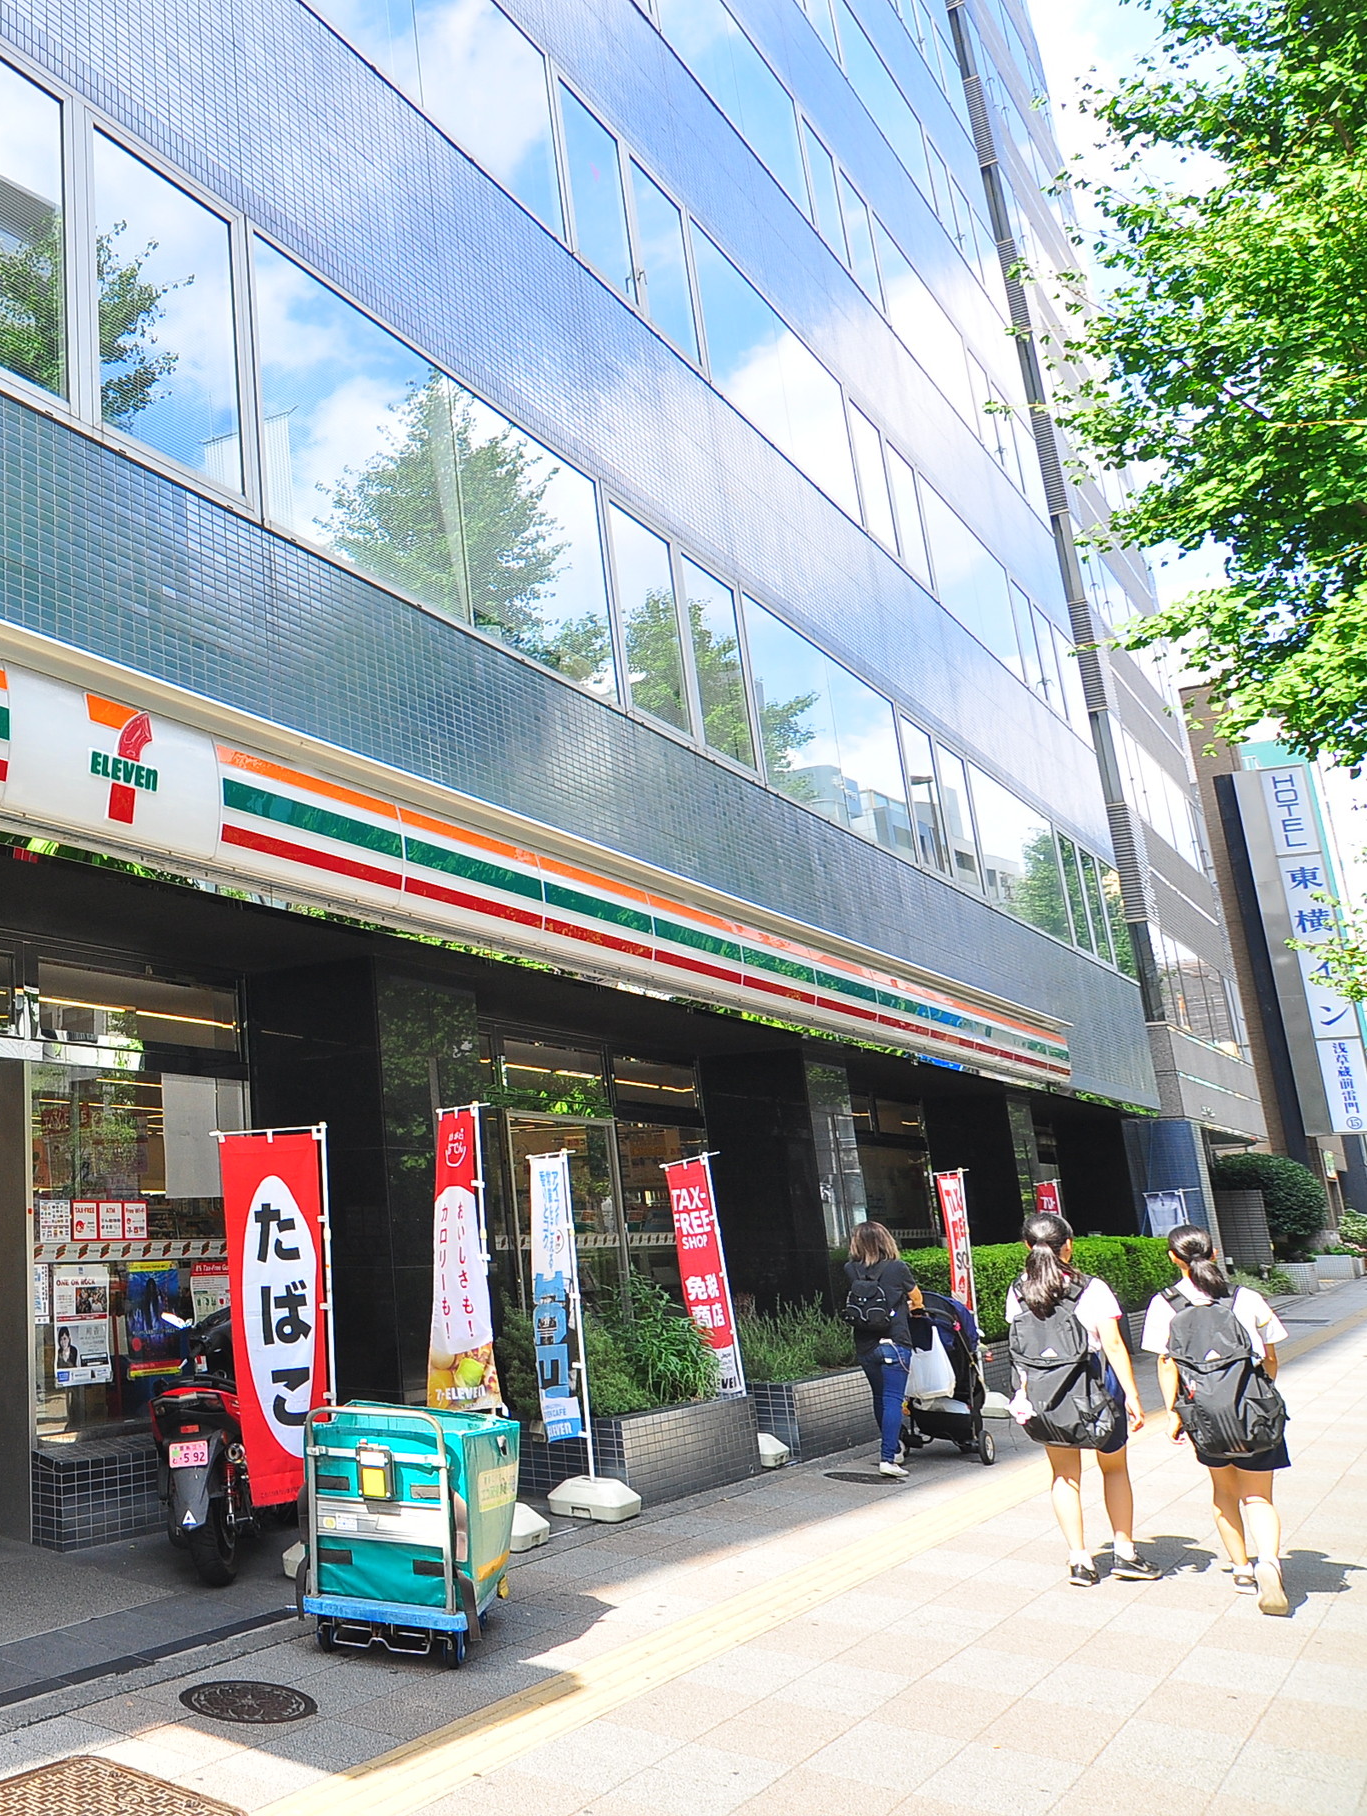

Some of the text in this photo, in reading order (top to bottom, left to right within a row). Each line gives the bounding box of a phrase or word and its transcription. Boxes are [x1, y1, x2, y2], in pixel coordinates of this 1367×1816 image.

[90, 750, 159, 792] ELEVEN
[1271, 774, 1307, 847] HOTEL
[670, 1185, 707, 1213] TAX-
[674, 1209, 712, 1235] FREE
[681, 1236, 708, 1250] SHOP
[56, 1279, 69, 1287] ONE
[439, 1203, 451, 1340] カロリーも！
[457, 1201, 474, 1337] おいしさも！
[685, 1273, 720, 1301] 免税
[253, 1202, 313, 1427] たばこ
[690, 1302, 726, 1329] 商店
[435, 1384, 486, 1401] 7-ELEVEN
